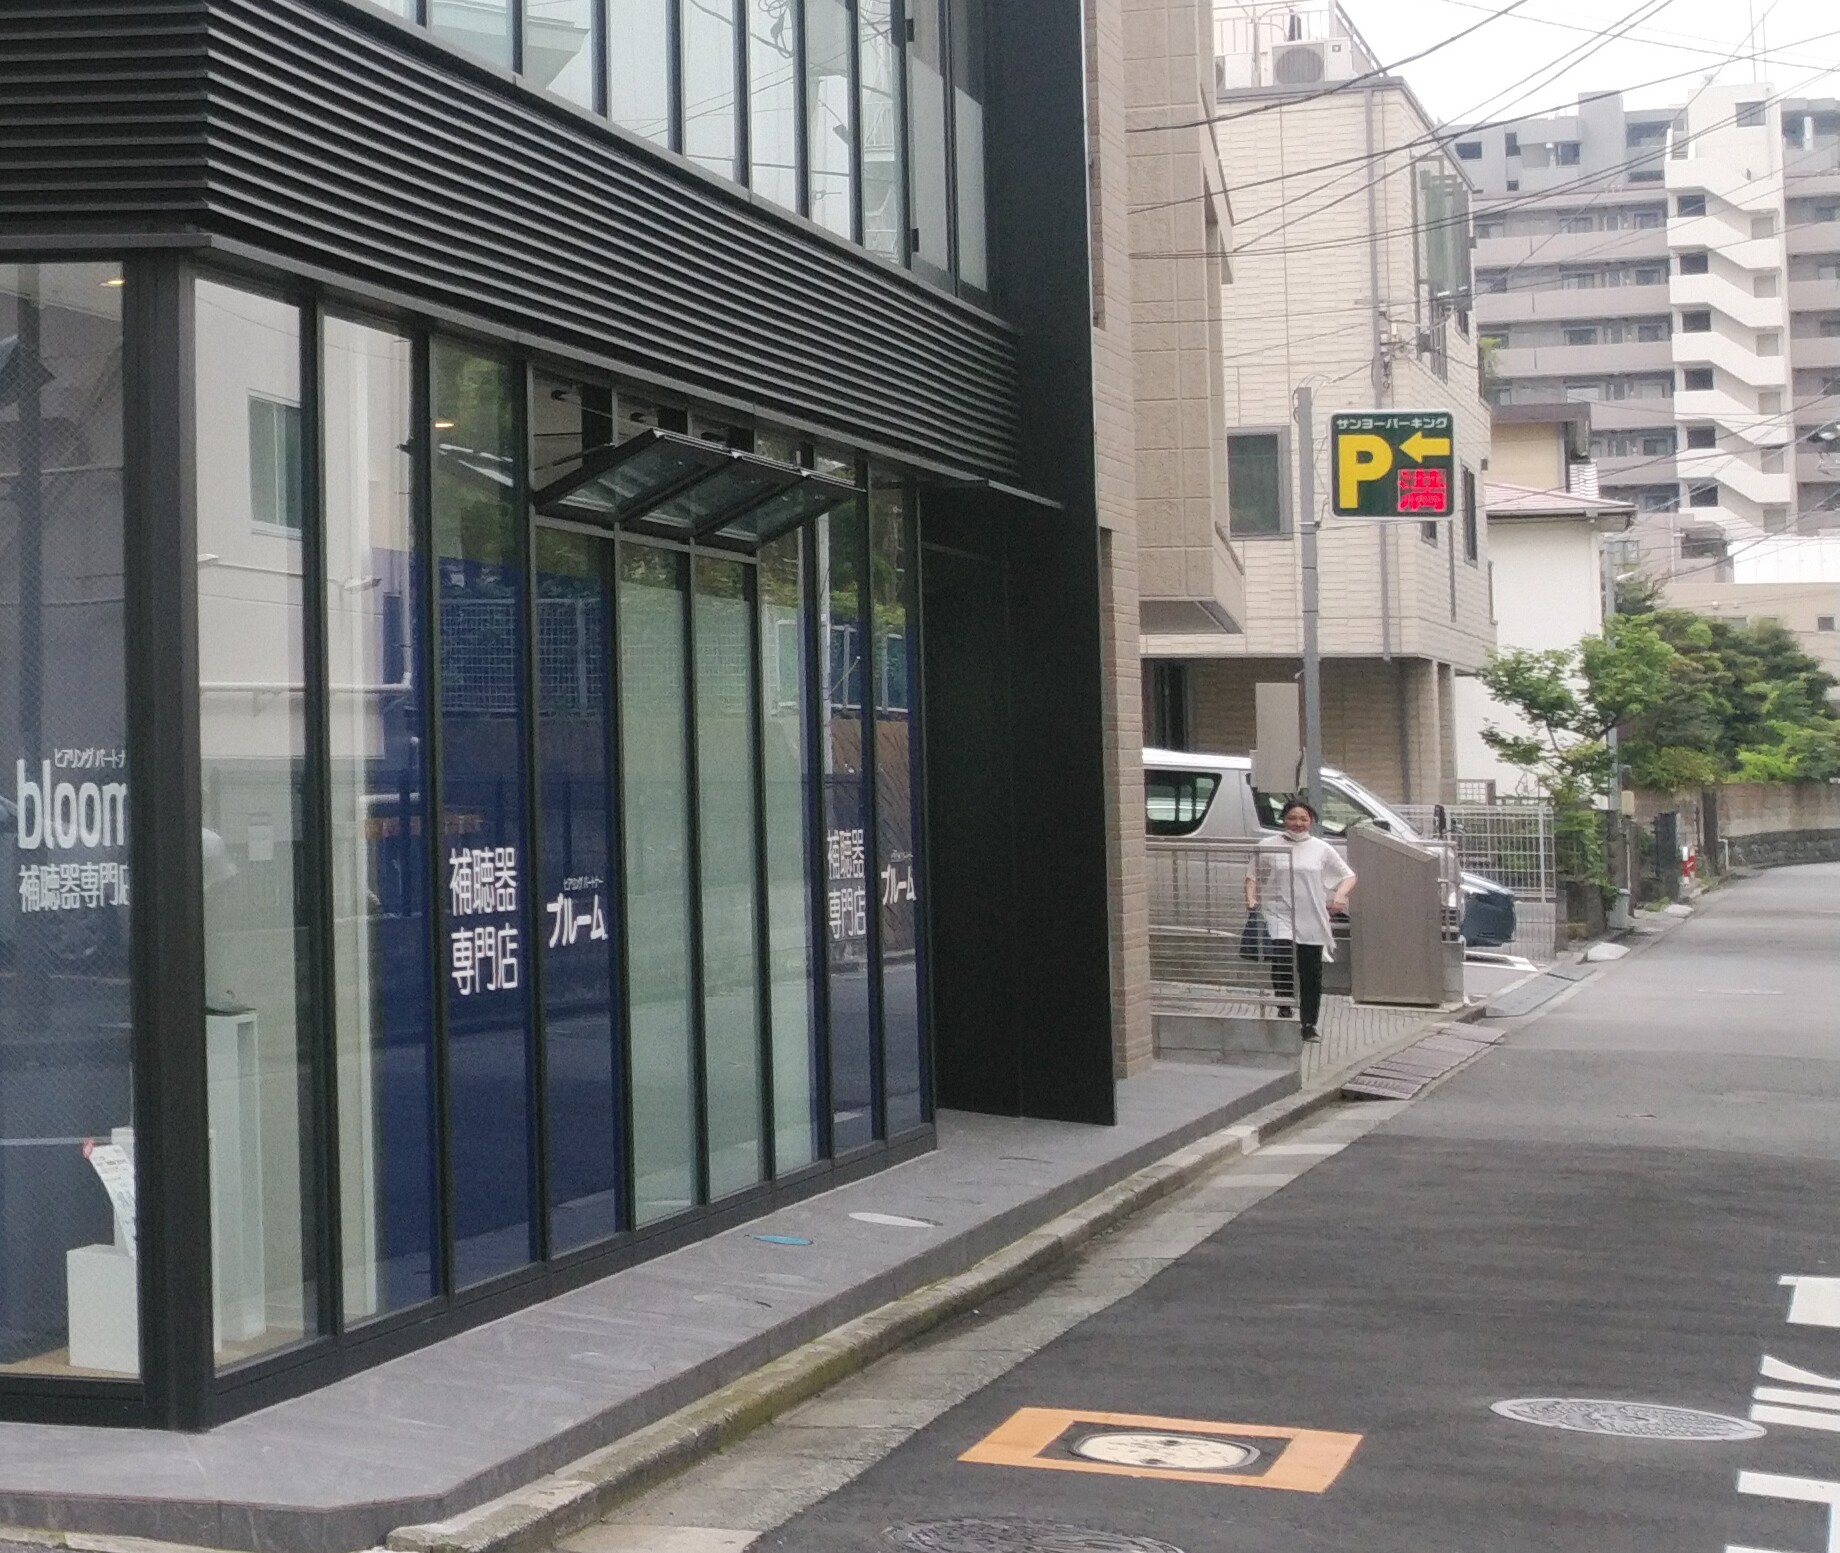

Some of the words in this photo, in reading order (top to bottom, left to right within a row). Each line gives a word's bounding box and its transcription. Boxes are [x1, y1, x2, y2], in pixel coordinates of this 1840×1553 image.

[1336, 417, 1448, 430] サンヨーパーキング
[1338, 435, 1393, 509] P
[448, 846, 517, 917] 補聴器
[827, 829, 864, 881] 補聴器
[546, 892, 608, 949] ブルーム
[451, 922, 518, 996] 専門店
